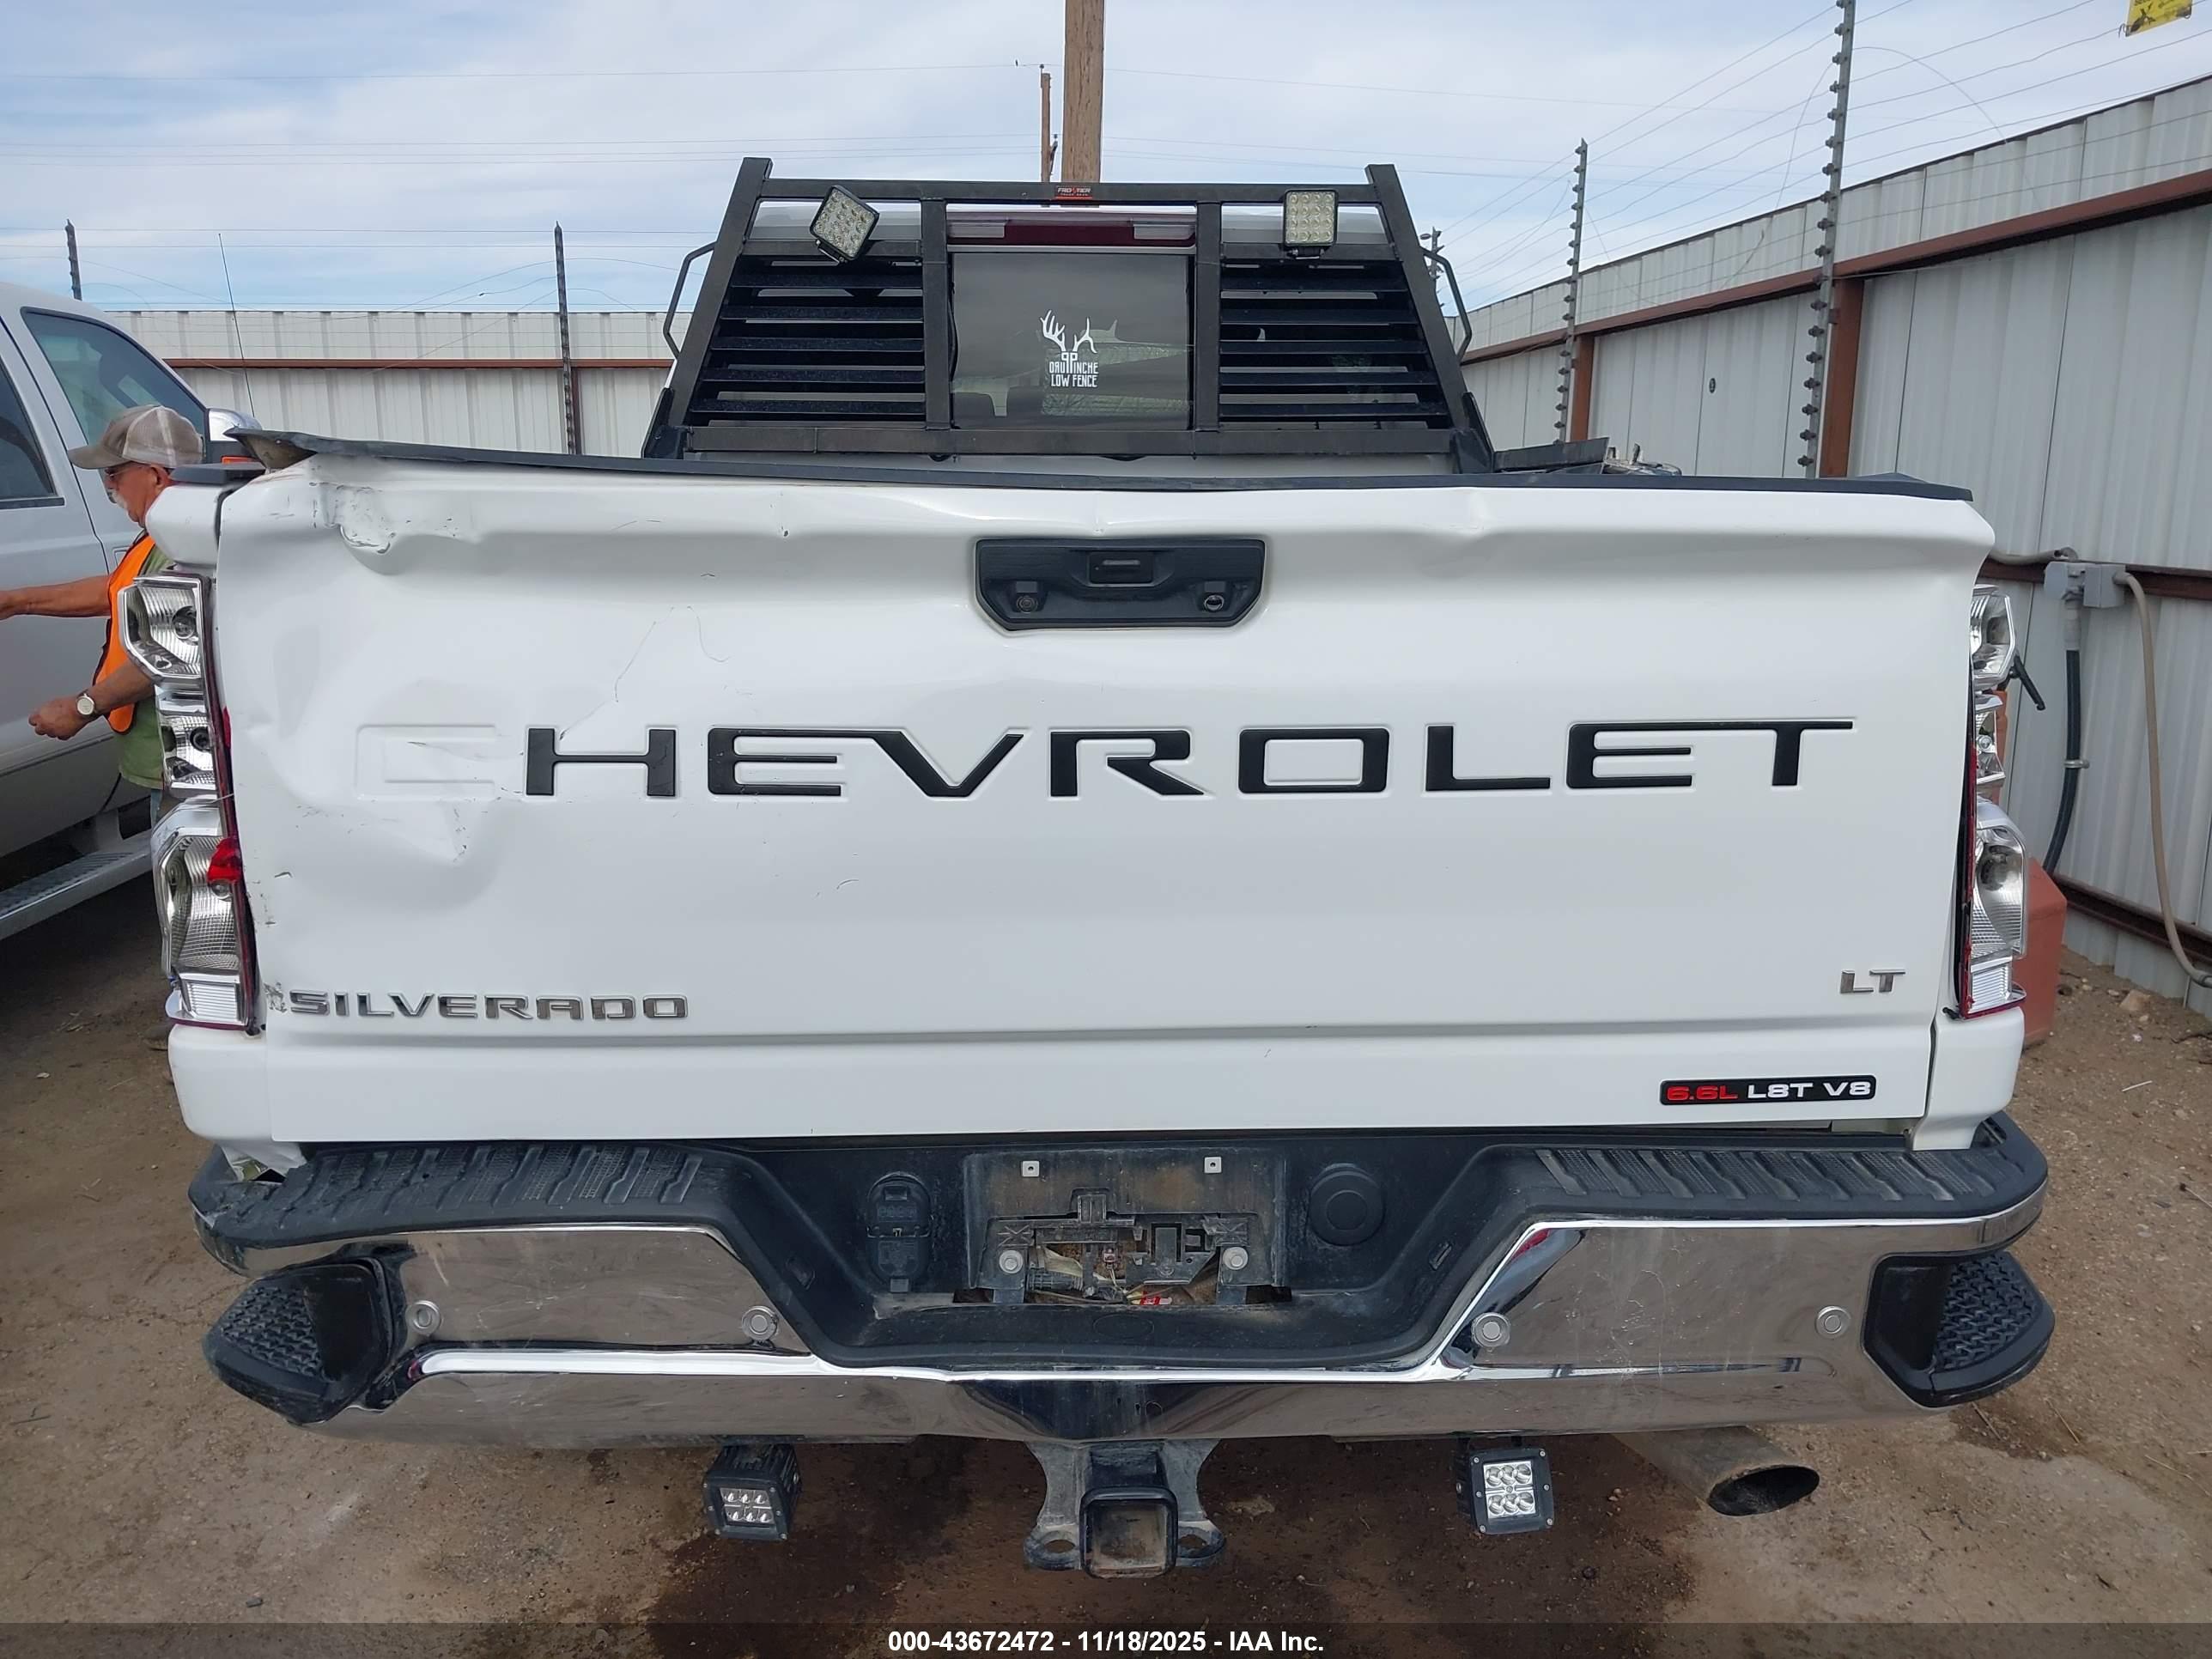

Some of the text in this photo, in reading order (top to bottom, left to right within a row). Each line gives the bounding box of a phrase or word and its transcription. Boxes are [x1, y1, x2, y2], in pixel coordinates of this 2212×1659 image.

[1051, 374, 1097, 387] LOW FENCE
[1839, 969, 1905, 994] LT
[289, 989, 688, 1019] SILVERADO
[1667, 1080, 1871, 1101] 6.6L L8T V8
